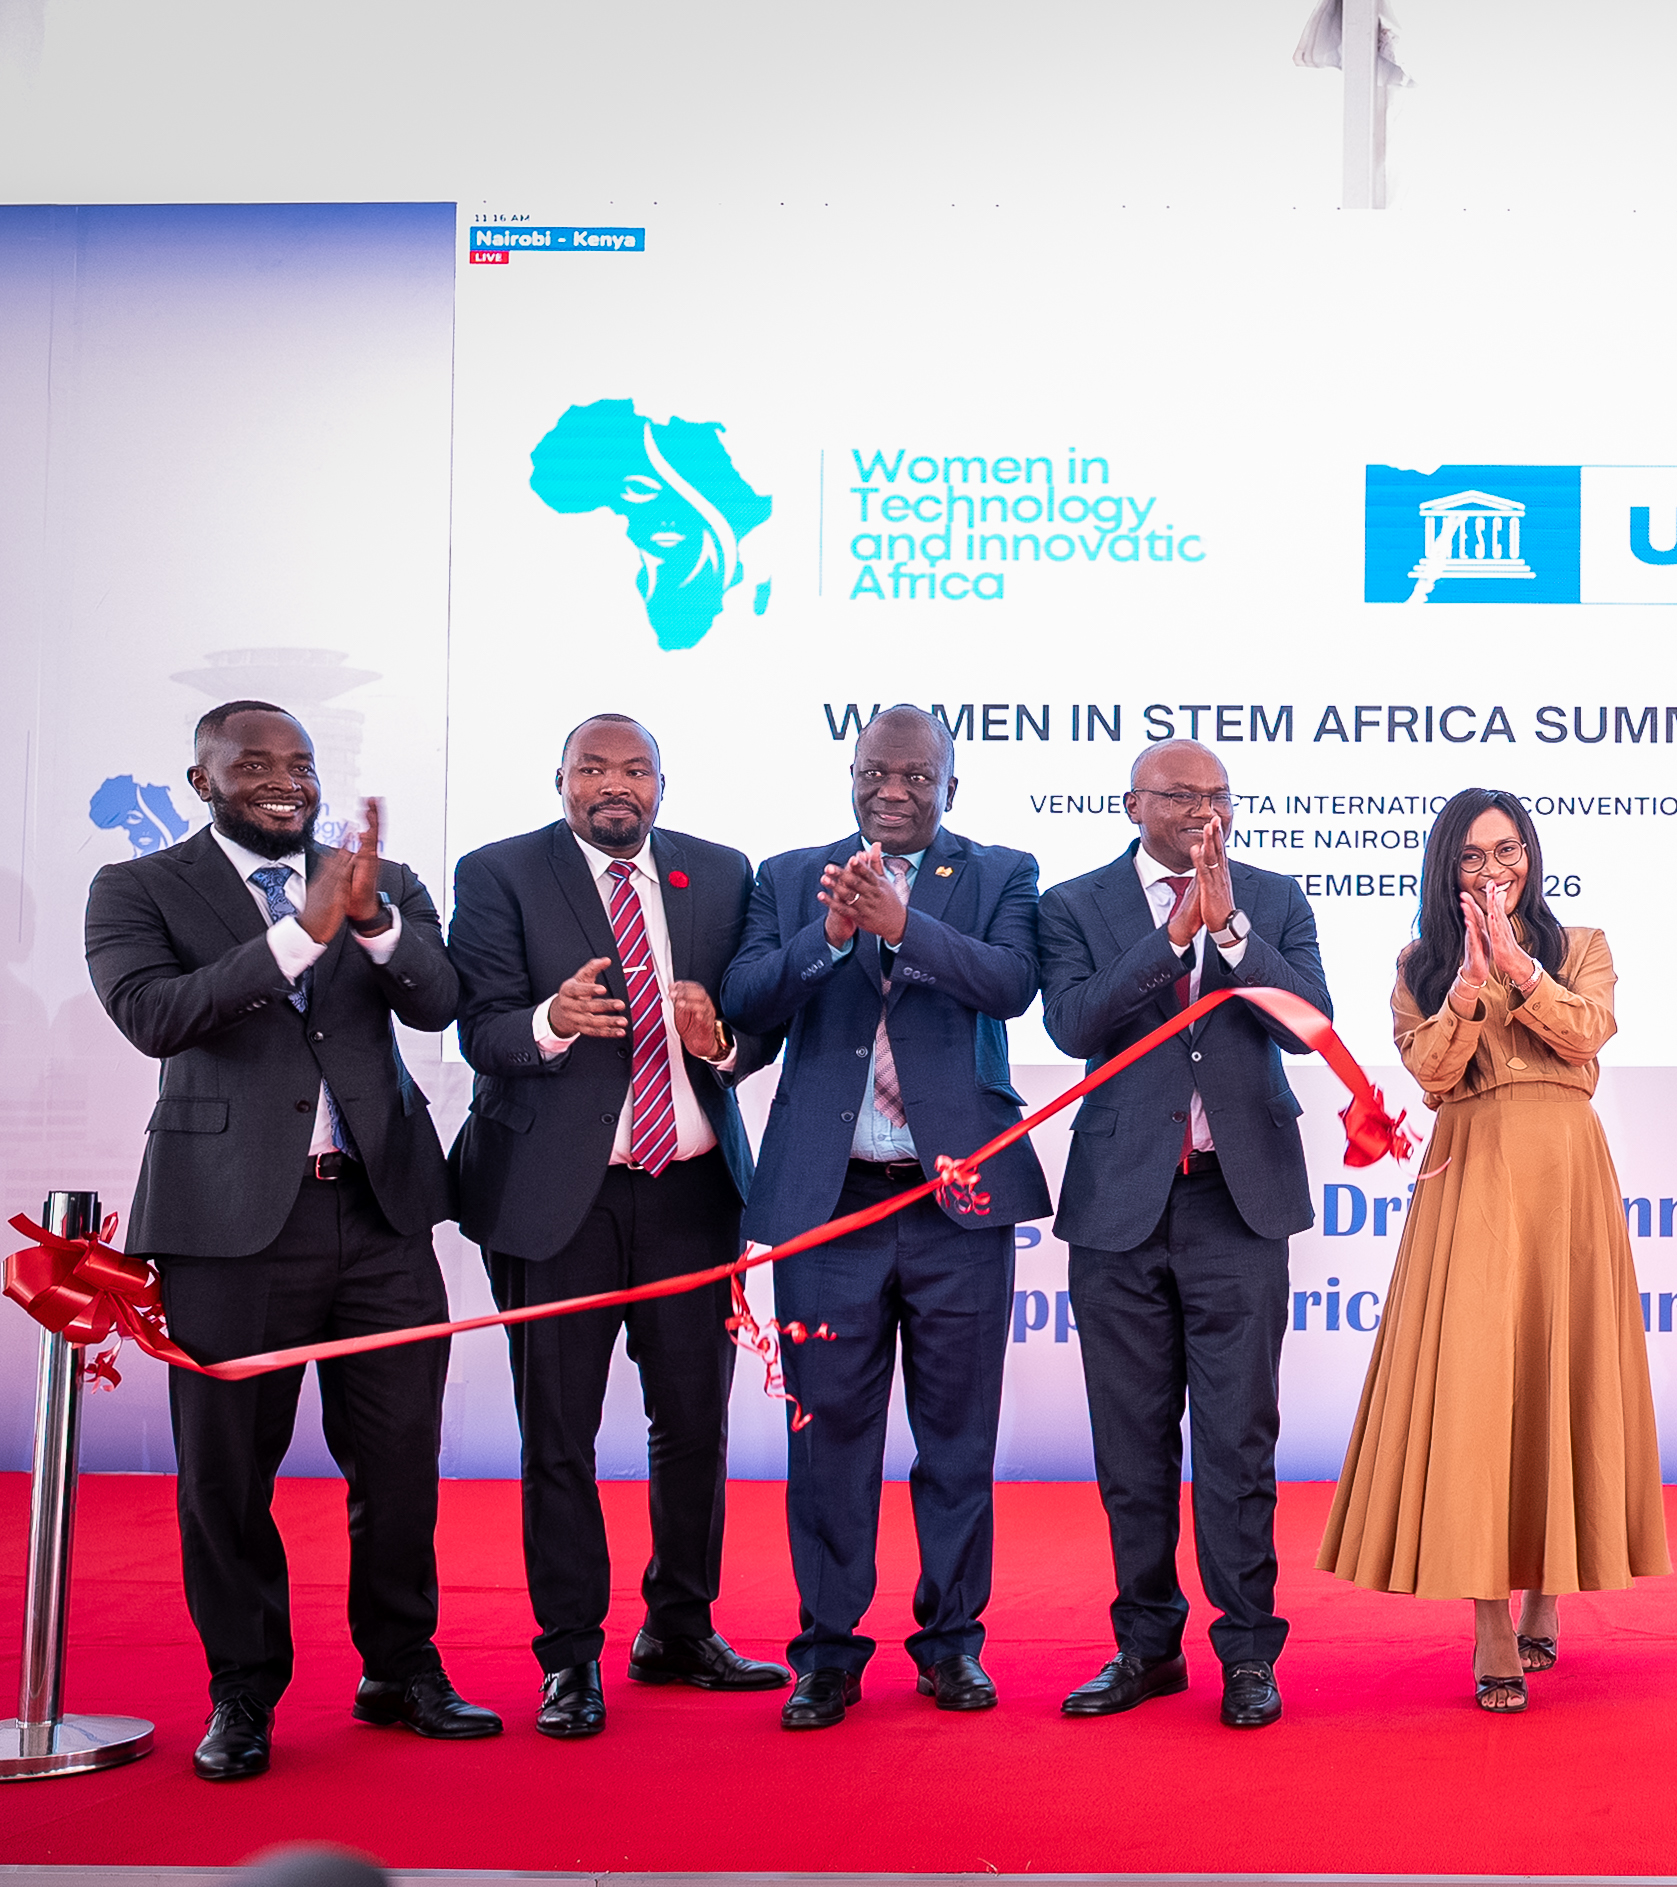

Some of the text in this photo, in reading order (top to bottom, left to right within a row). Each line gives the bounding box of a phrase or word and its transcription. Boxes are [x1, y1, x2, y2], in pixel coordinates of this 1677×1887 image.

[475, 253, 503, 262] LIVE
[476, 231, 551, 247] Nairobi
[573, 232, 636, 250] Kenya
[850, 446, 1110, 484] Women in
[850, 485, 1157, 534] Technology
[850, 524, 952, 561] and
[849, 562, 1004, 600] Africa
[823, 703, 1050, 741] WMEN
[1072, 704, 1122, 742] IN
[1143, 703, 1293, 743] STEM
[1312, 704, 1517, 744] AFRICA
[1286, 795, 1448, 814] INTERNATIO
[1234, 829, 1304, 849] NTRE
